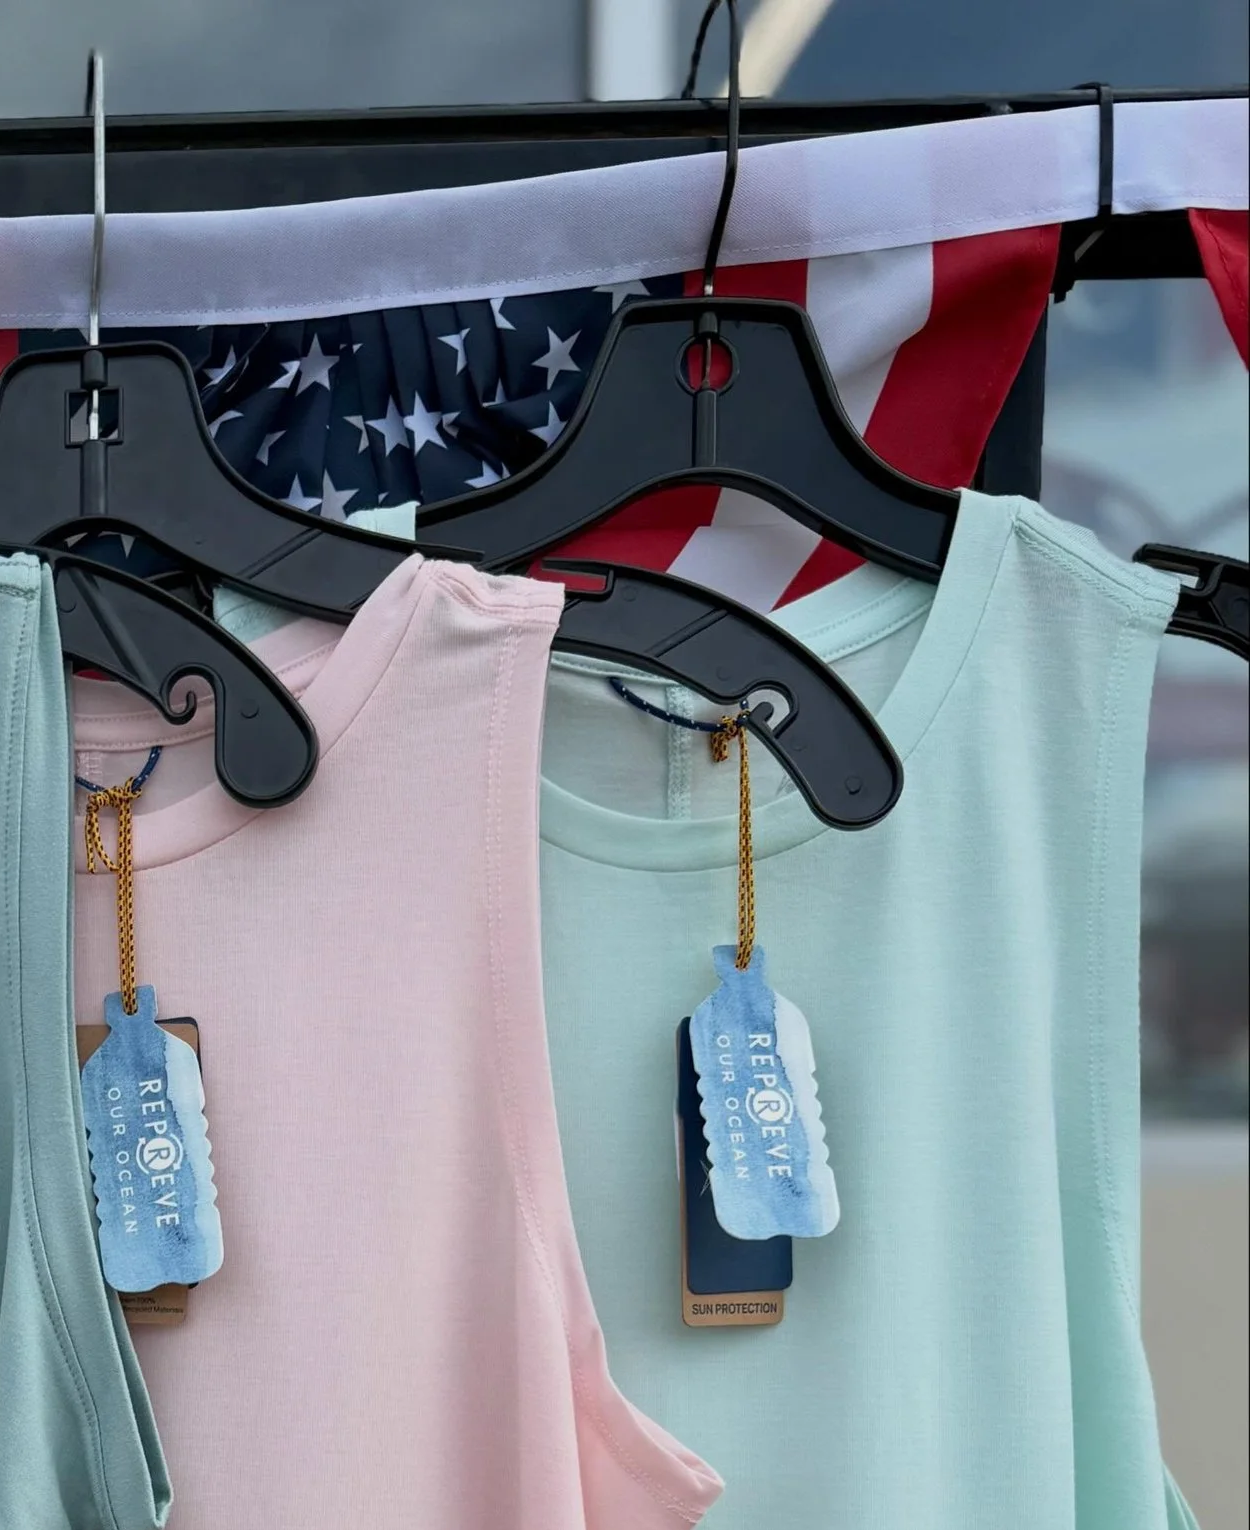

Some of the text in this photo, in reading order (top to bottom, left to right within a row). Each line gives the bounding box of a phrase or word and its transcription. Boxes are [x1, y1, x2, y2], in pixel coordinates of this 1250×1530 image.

[716, 1034, 736, 1082] OUR
[107, 1088, 126, 1137] OUR
[747, 1032, 793, 1180] REPREVE
[137, 1078, 182, 1228] REPREVE
[692, 1302, 778, 1315] SUN PROTECTION
